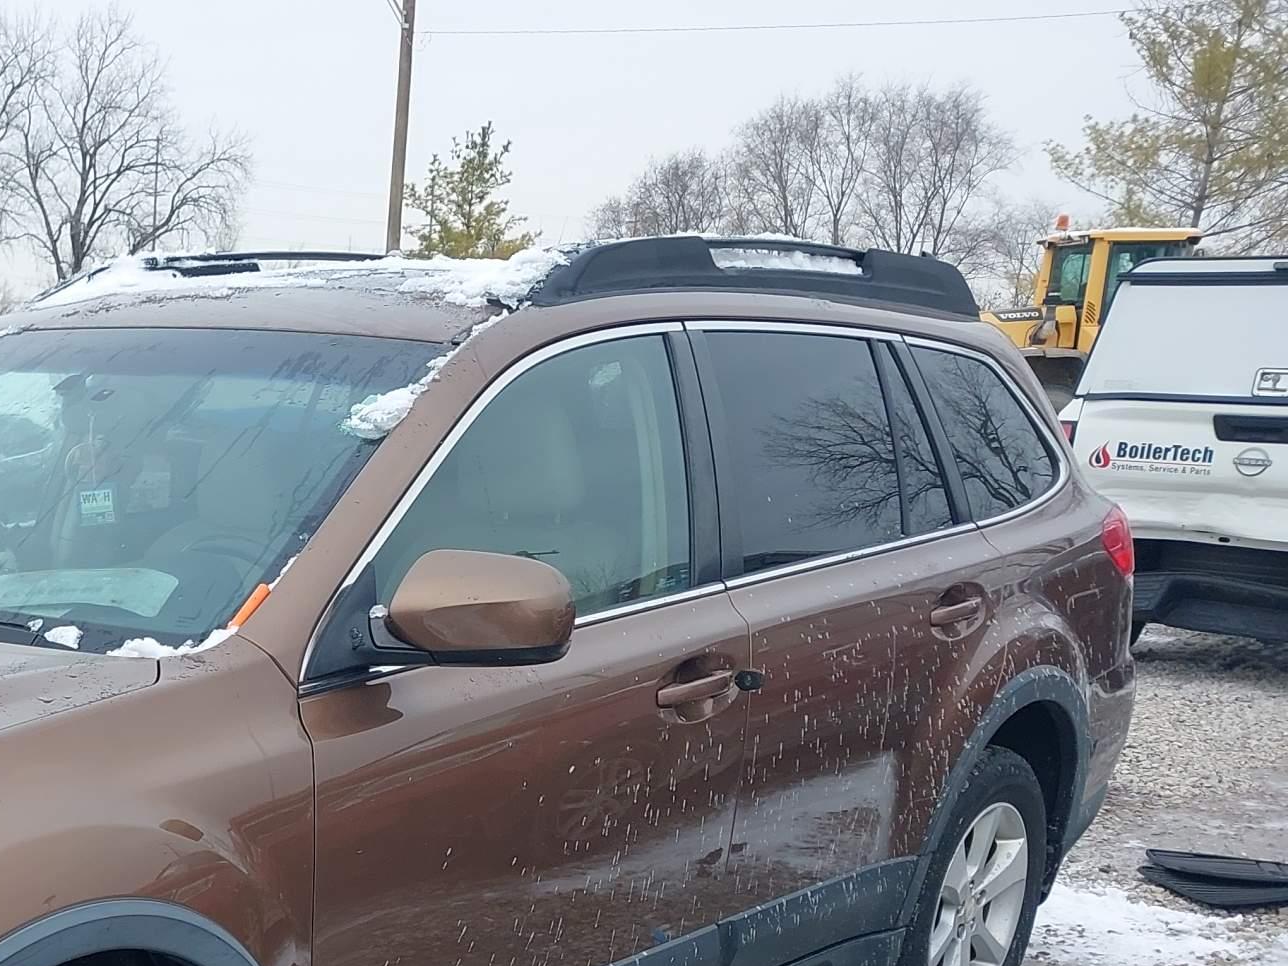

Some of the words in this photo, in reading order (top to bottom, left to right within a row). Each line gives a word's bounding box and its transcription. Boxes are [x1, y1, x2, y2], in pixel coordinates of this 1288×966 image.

[999, 311, 1039, 319] VOLVO
[1117, 442, 1213, 463] BoilerTech
[1112, 463, 1146, 472] Systems,
[1149, 464, 1179, 474] Service
[1181, 466, 1187, 474] &
[1190, 467, 1211, 475] Parts
[82, 491, 110, 504] WAH
